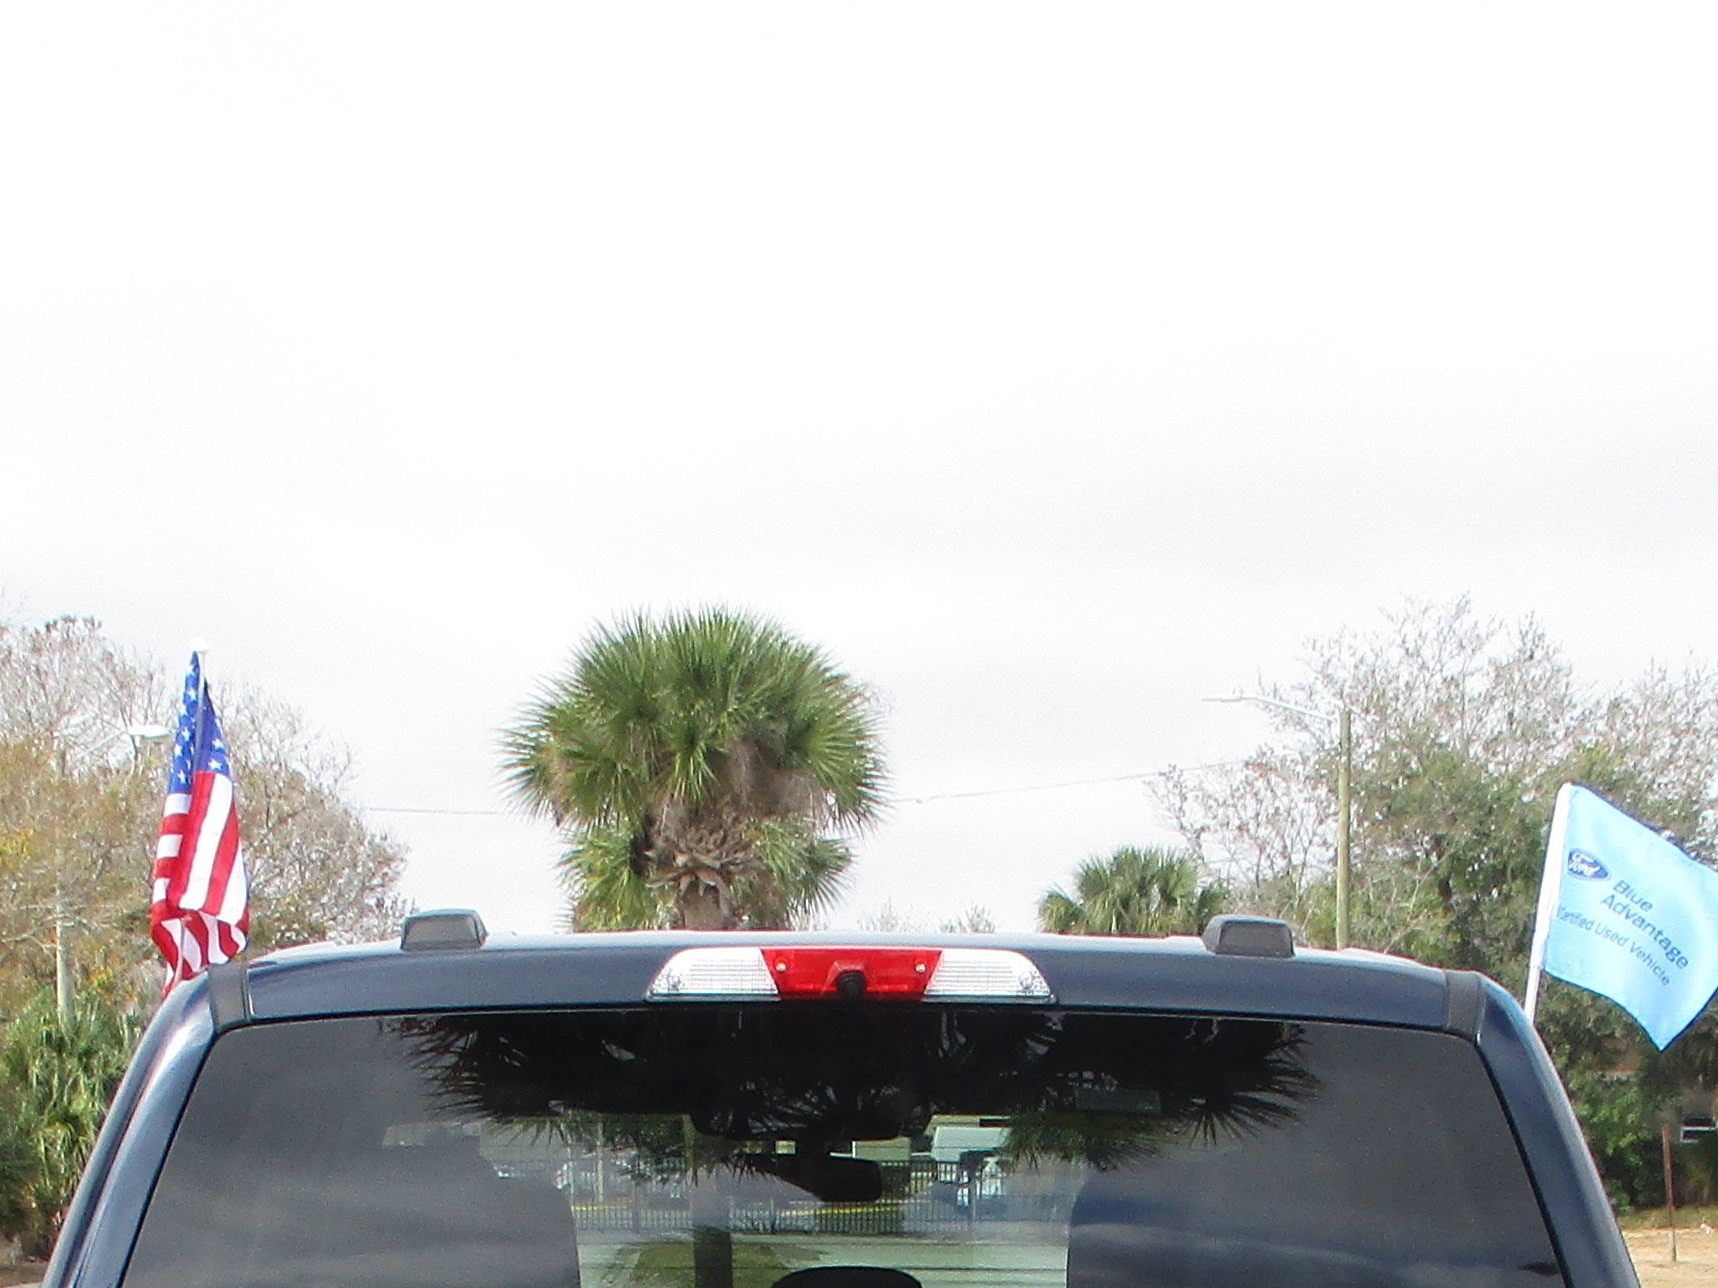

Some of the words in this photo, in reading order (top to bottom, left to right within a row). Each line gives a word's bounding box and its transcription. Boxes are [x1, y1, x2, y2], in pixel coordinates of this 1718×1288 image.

[1613, 880, 1653, 912] Blue
[1594, 921, 1630, 947] Used
[1629, 941, 1670, 986] Vehicle
[1598, 894, 1689, 970] Advantage
